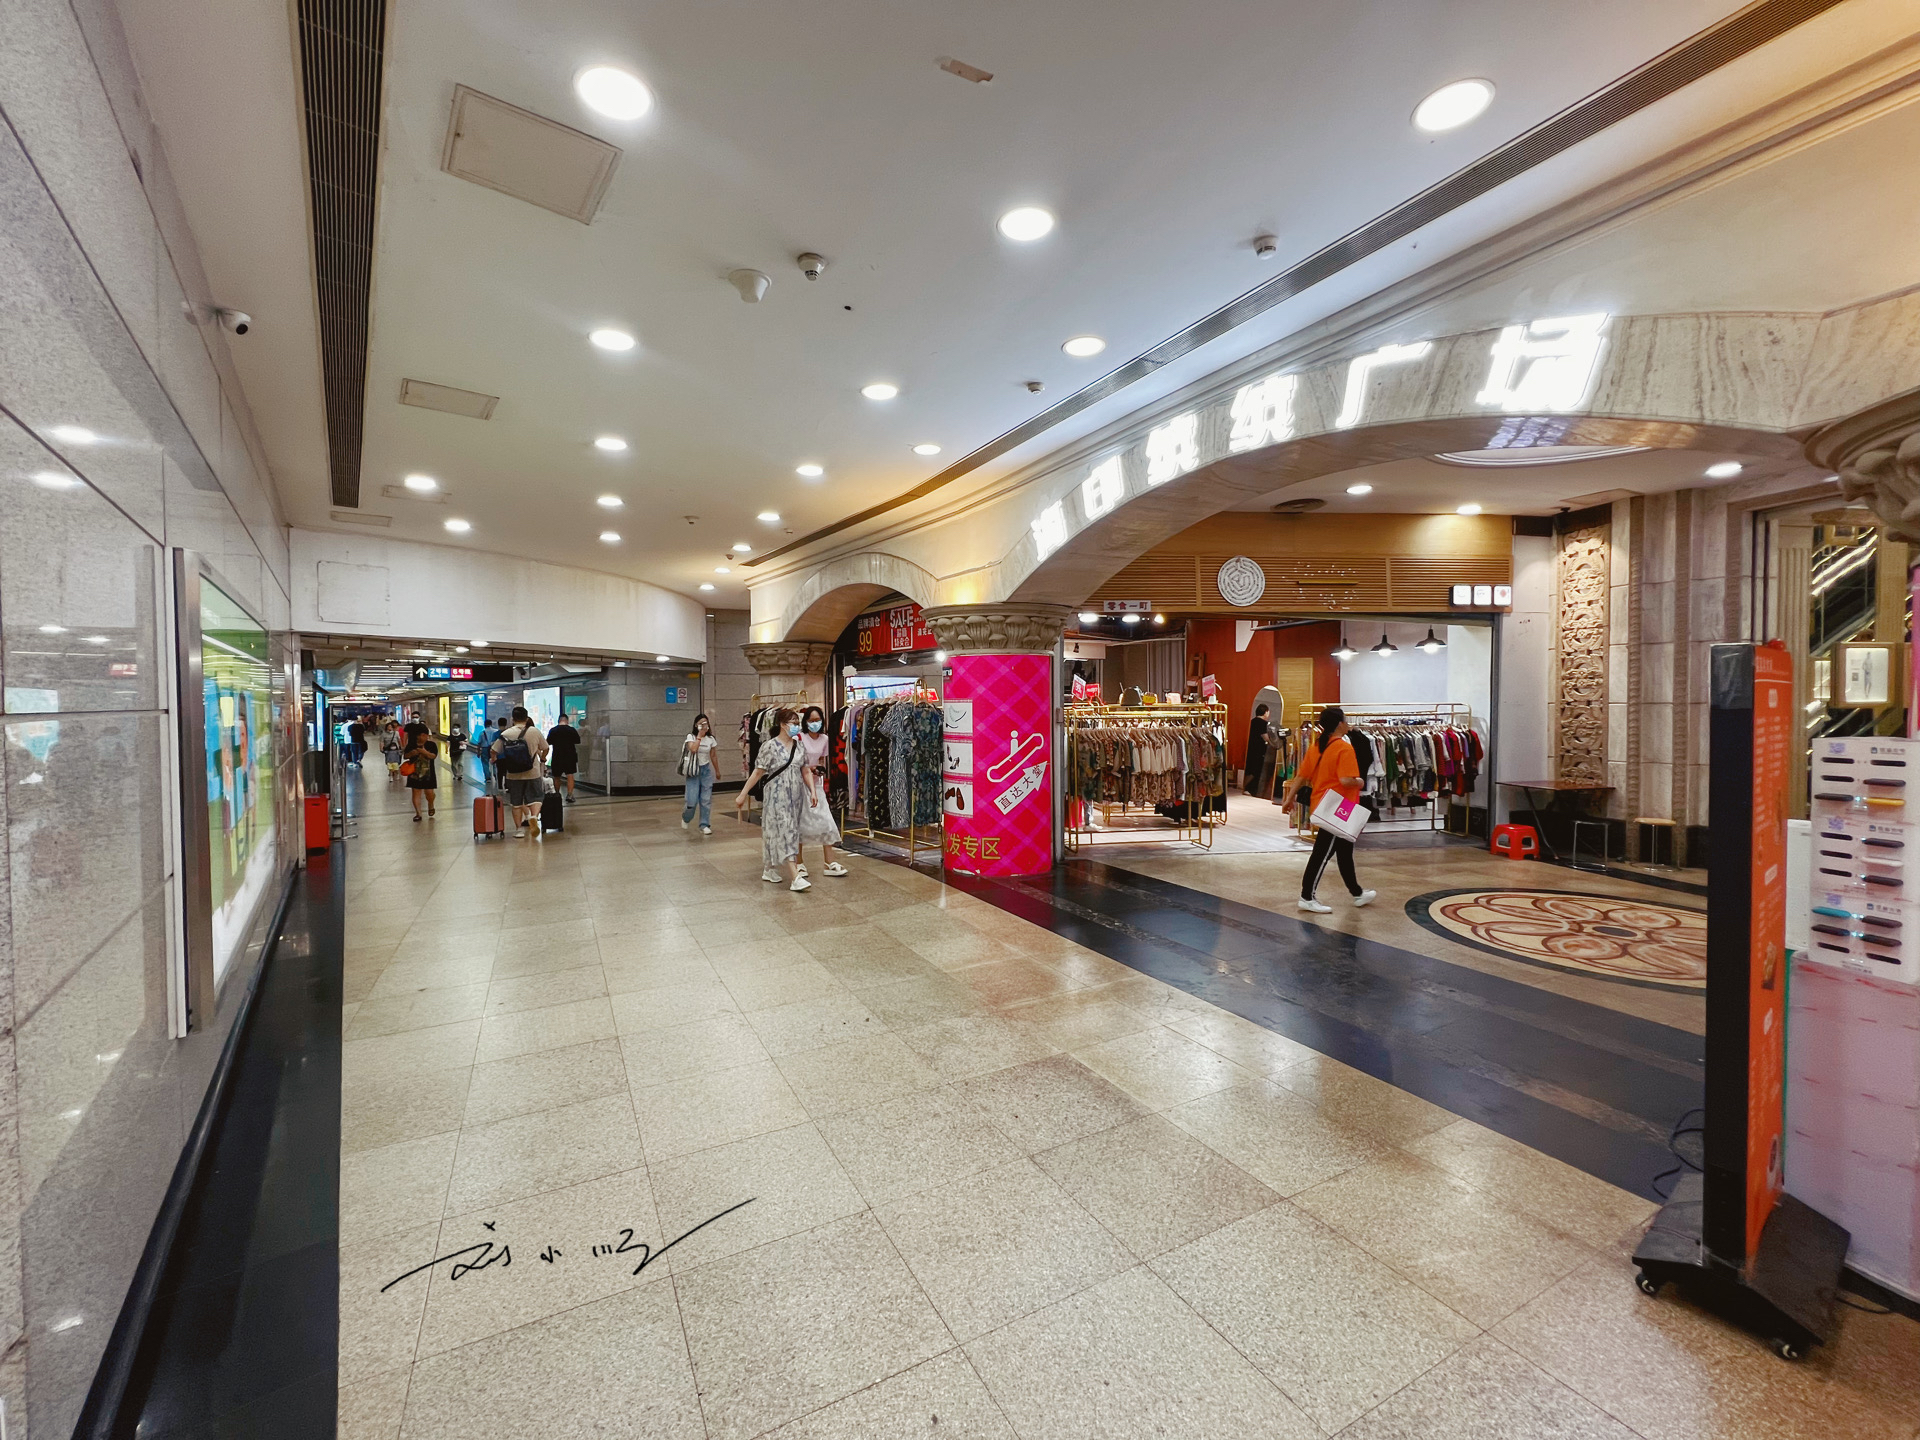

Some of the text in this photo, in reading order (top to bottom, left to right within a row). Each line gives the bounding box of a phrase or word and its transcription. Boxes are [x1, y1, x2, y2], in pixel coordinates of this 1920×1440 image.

[1107, 601, 1149, 611] 零食一町
[890, 607, 914, 629] SALE
[859, 630, 873, 653] 99
[998, 764, 1043, 810] 直达大堂
[945, 832, 1001, 860] 发专区
